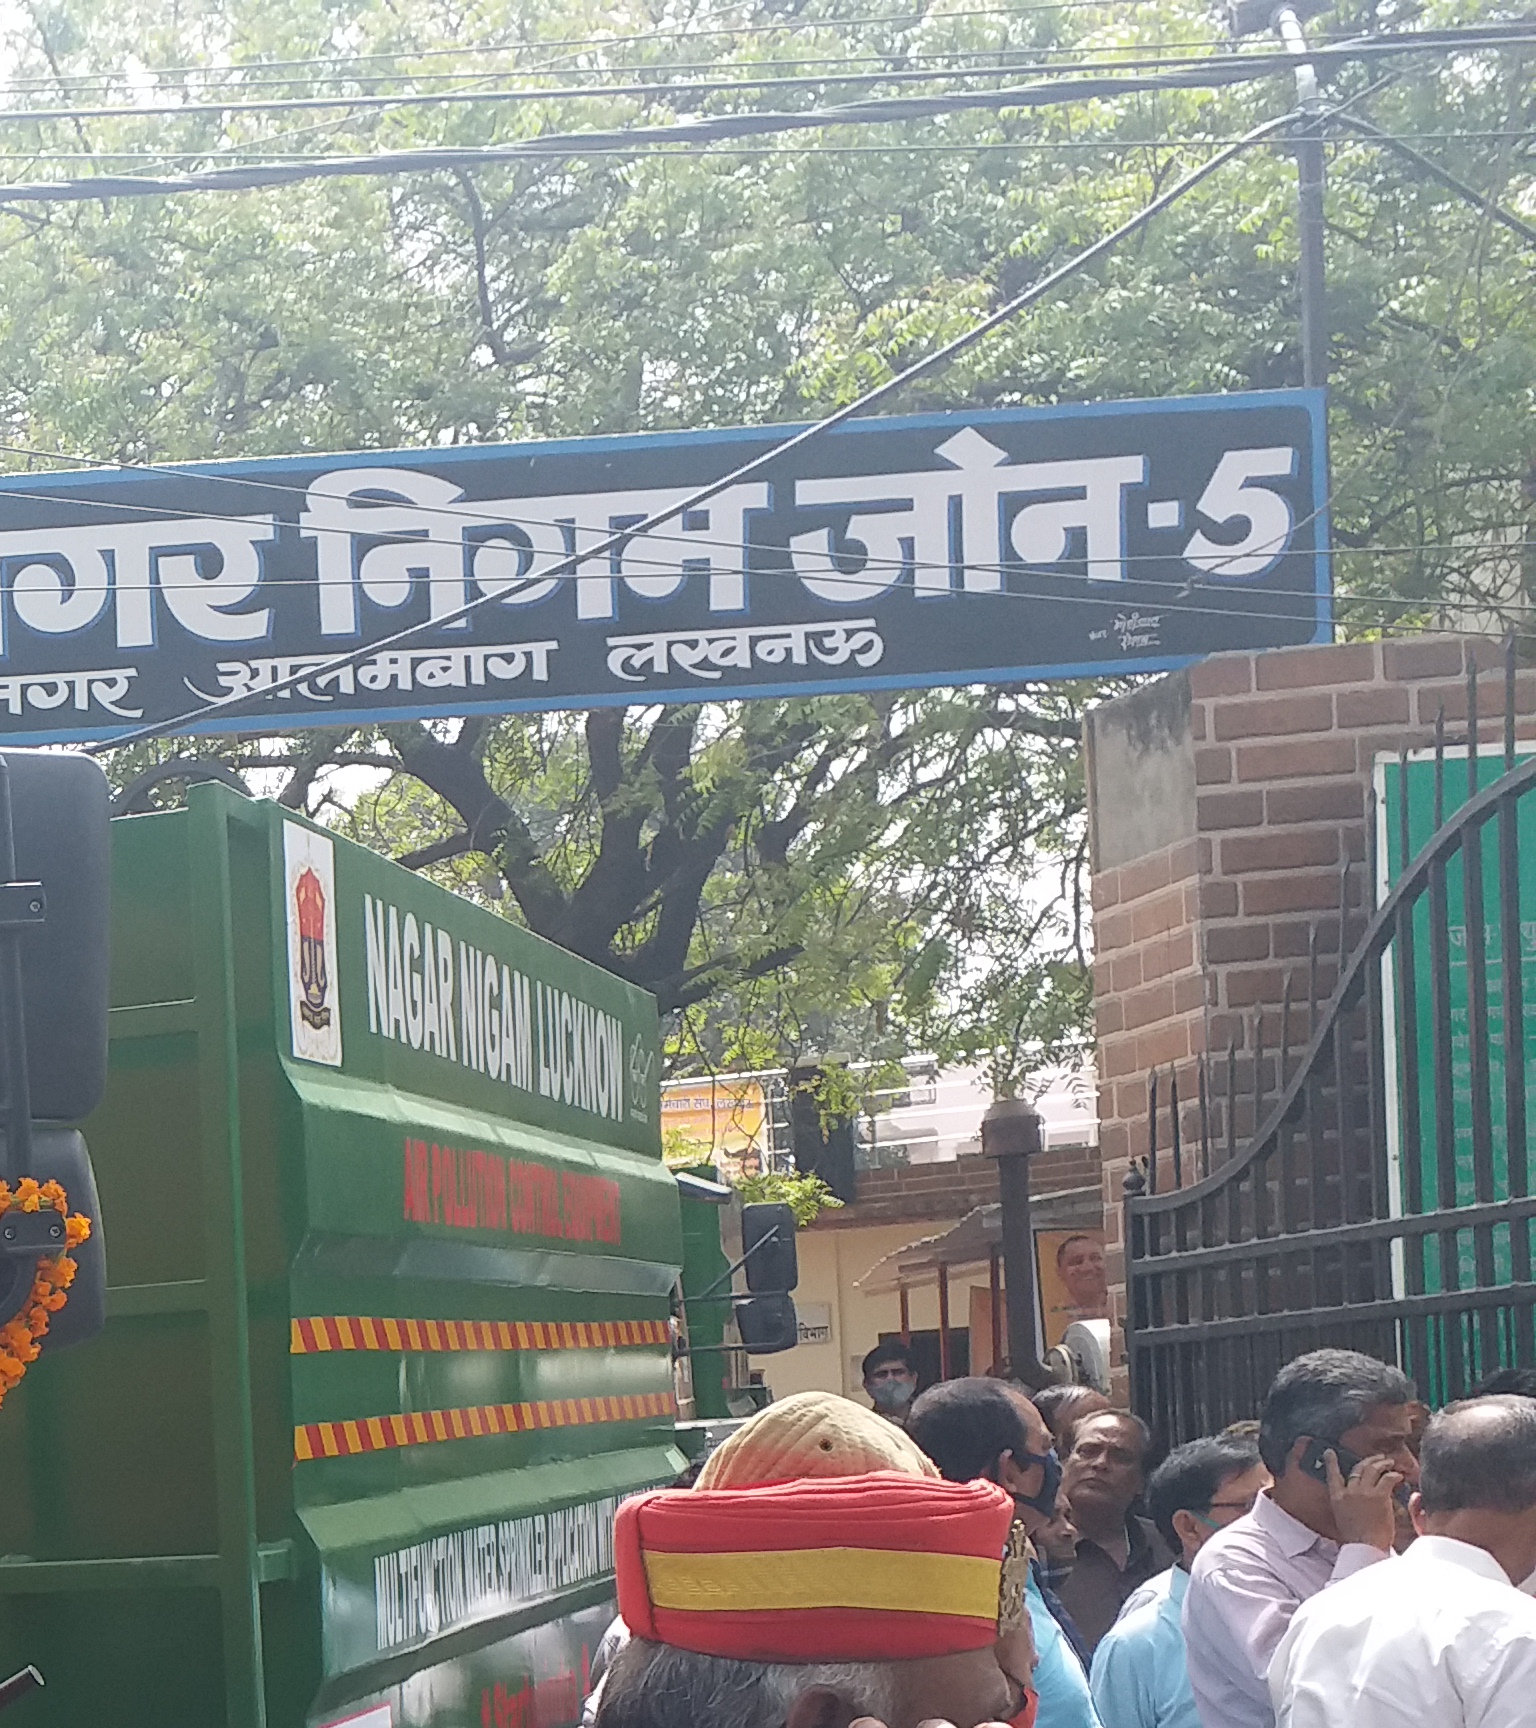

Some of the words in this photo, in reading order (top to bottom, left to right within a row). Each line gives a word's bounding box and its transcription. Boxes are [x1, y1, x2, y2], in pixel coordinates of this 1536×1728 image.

[304, 467, 772, 636] निगम
[182, 640, 560, 706] आलमबाग
[605, 617, 884, 683] लखनऊ
[364, 893, 458, 1062] NAGAR
[459, 940, 533, 1093] NIGAM
[536, 980, 623, 1123] LUCKNOW
